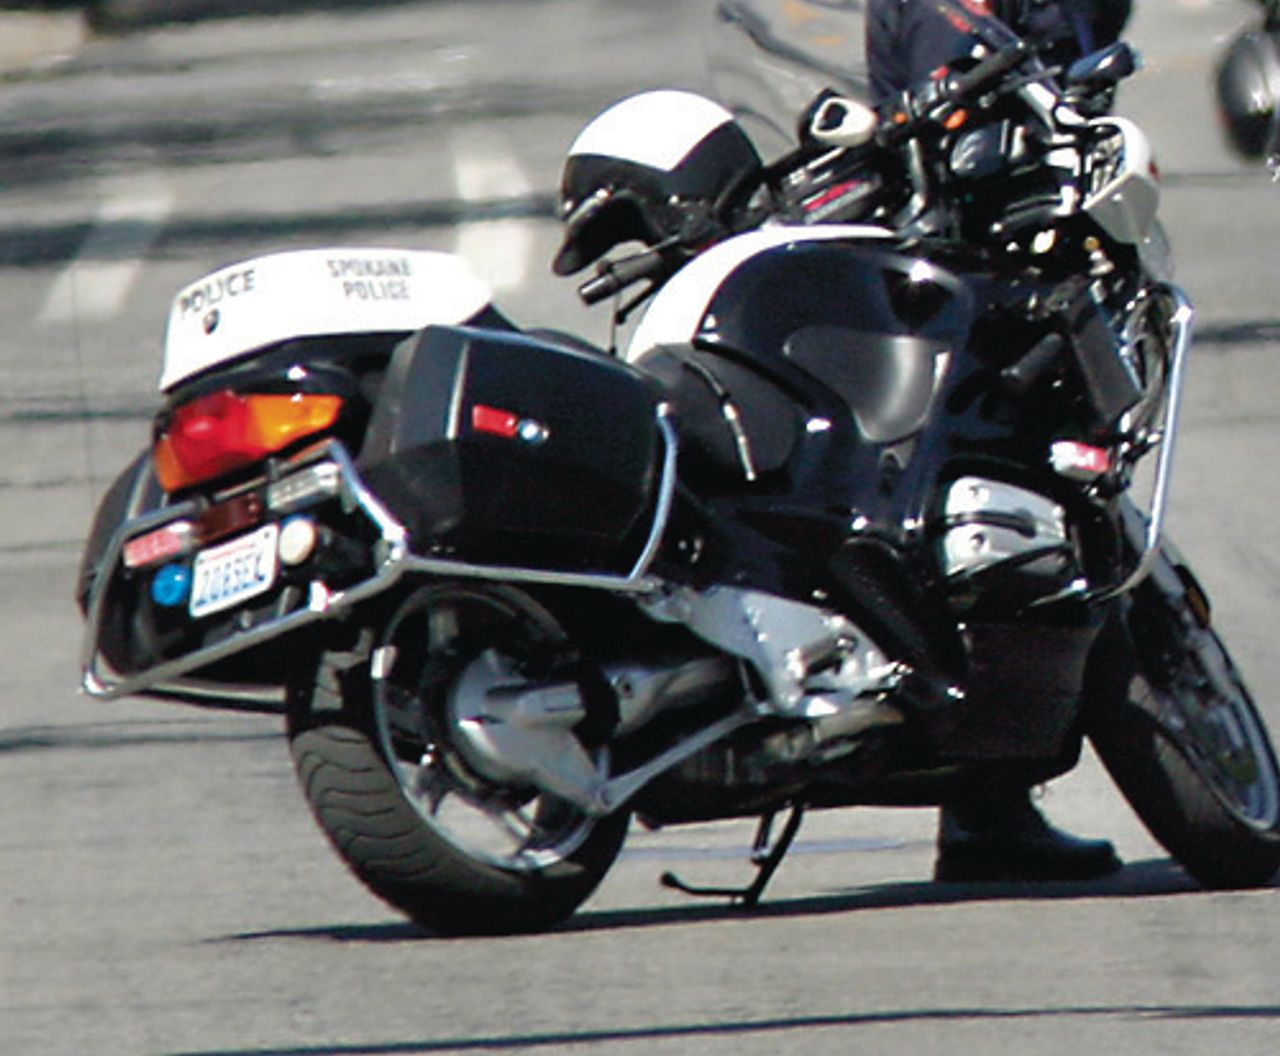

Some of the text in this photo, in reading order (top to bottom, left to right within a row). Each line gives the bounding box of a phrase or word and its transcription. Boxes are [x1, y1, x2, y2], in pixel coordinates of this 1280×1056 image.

[327, 258, 411, 278] SPOKANE
[180, 270, 255, 315] POLICE
[342, 280, 410, 300] POLICE
